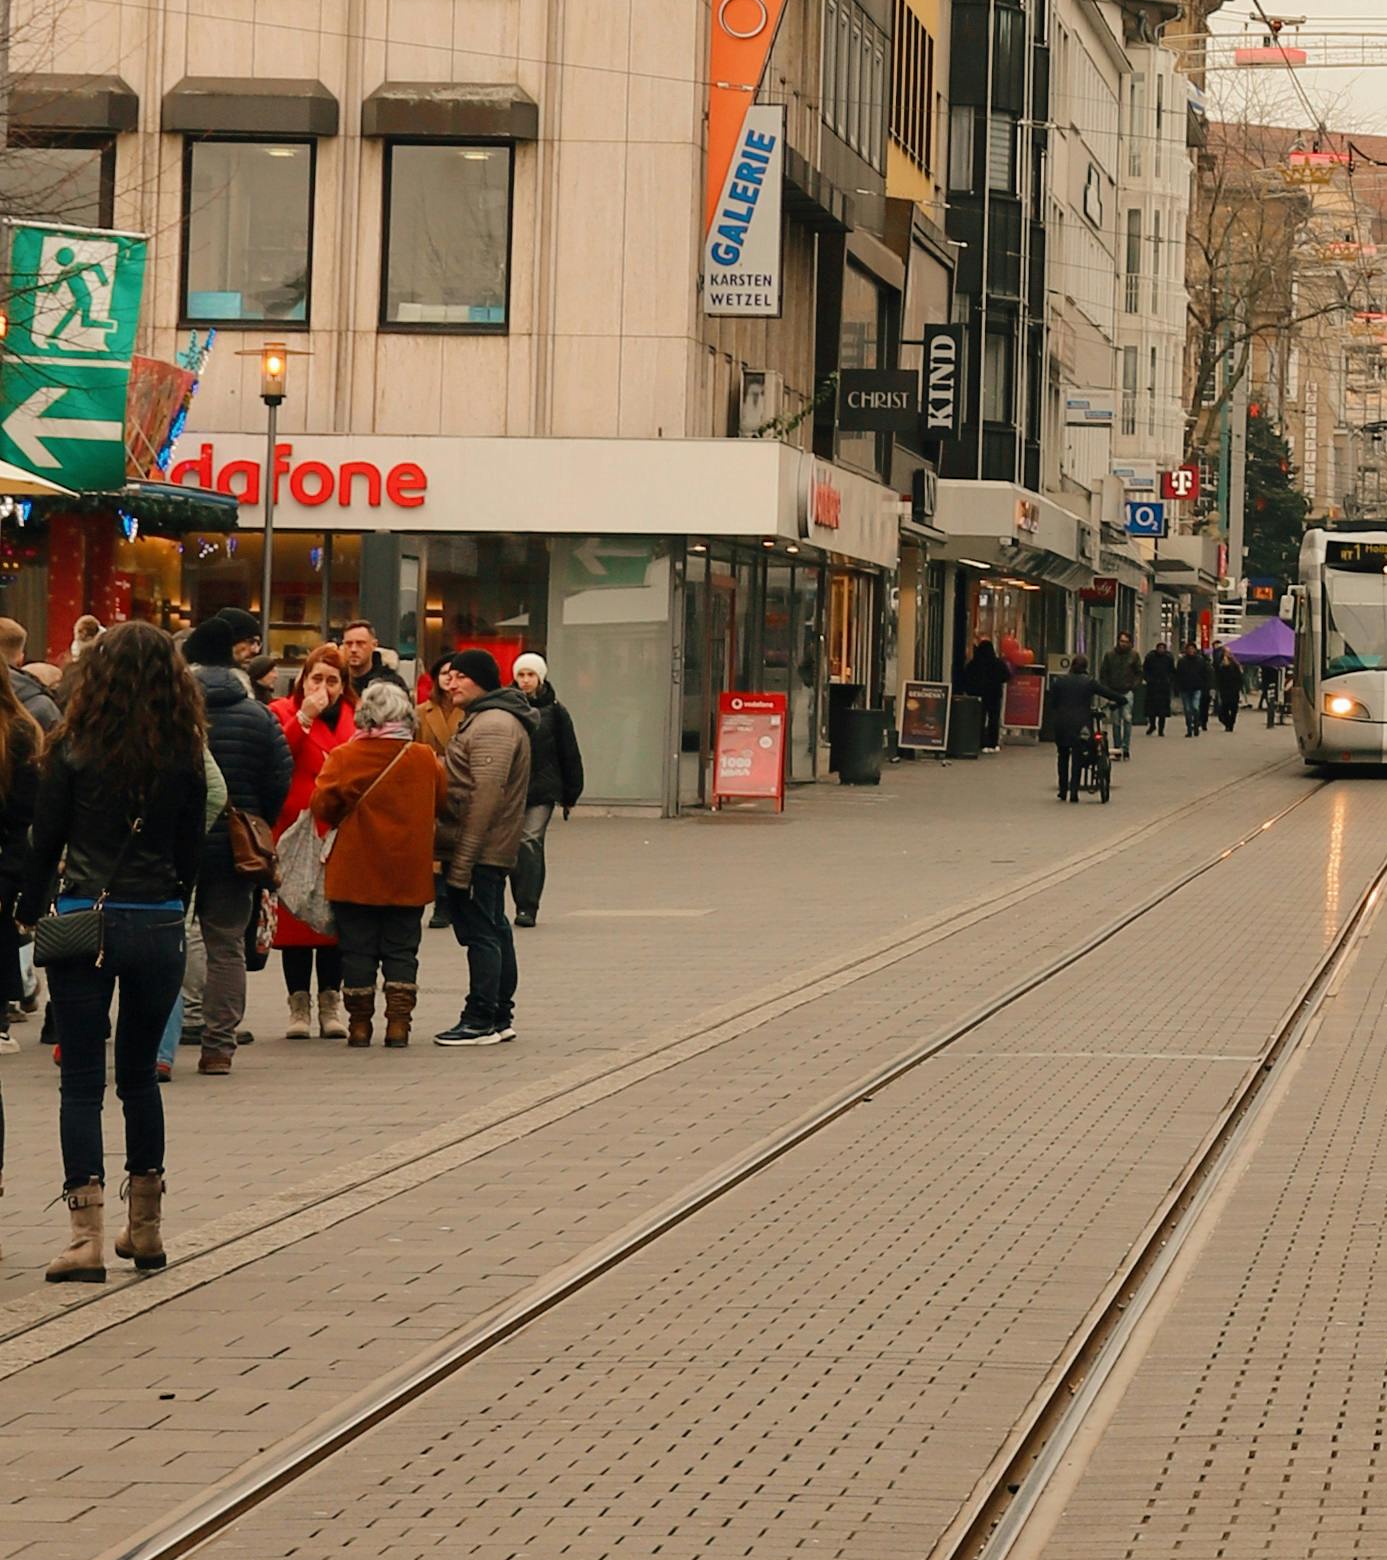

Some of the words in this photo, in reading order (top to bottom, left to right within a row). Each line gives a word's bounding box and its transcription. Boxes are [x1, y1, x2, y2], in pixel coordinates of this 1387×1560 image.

[711, 128, 776, 267] GALERIE
[710, 273, 772, 287] KARSTEN
[710, 293, 771, 307] WETZEL
[928, 335, 955, 429] KIND
[848, 391, 909, 408] CHRIST
[1171, 470, 1192, 495] T
